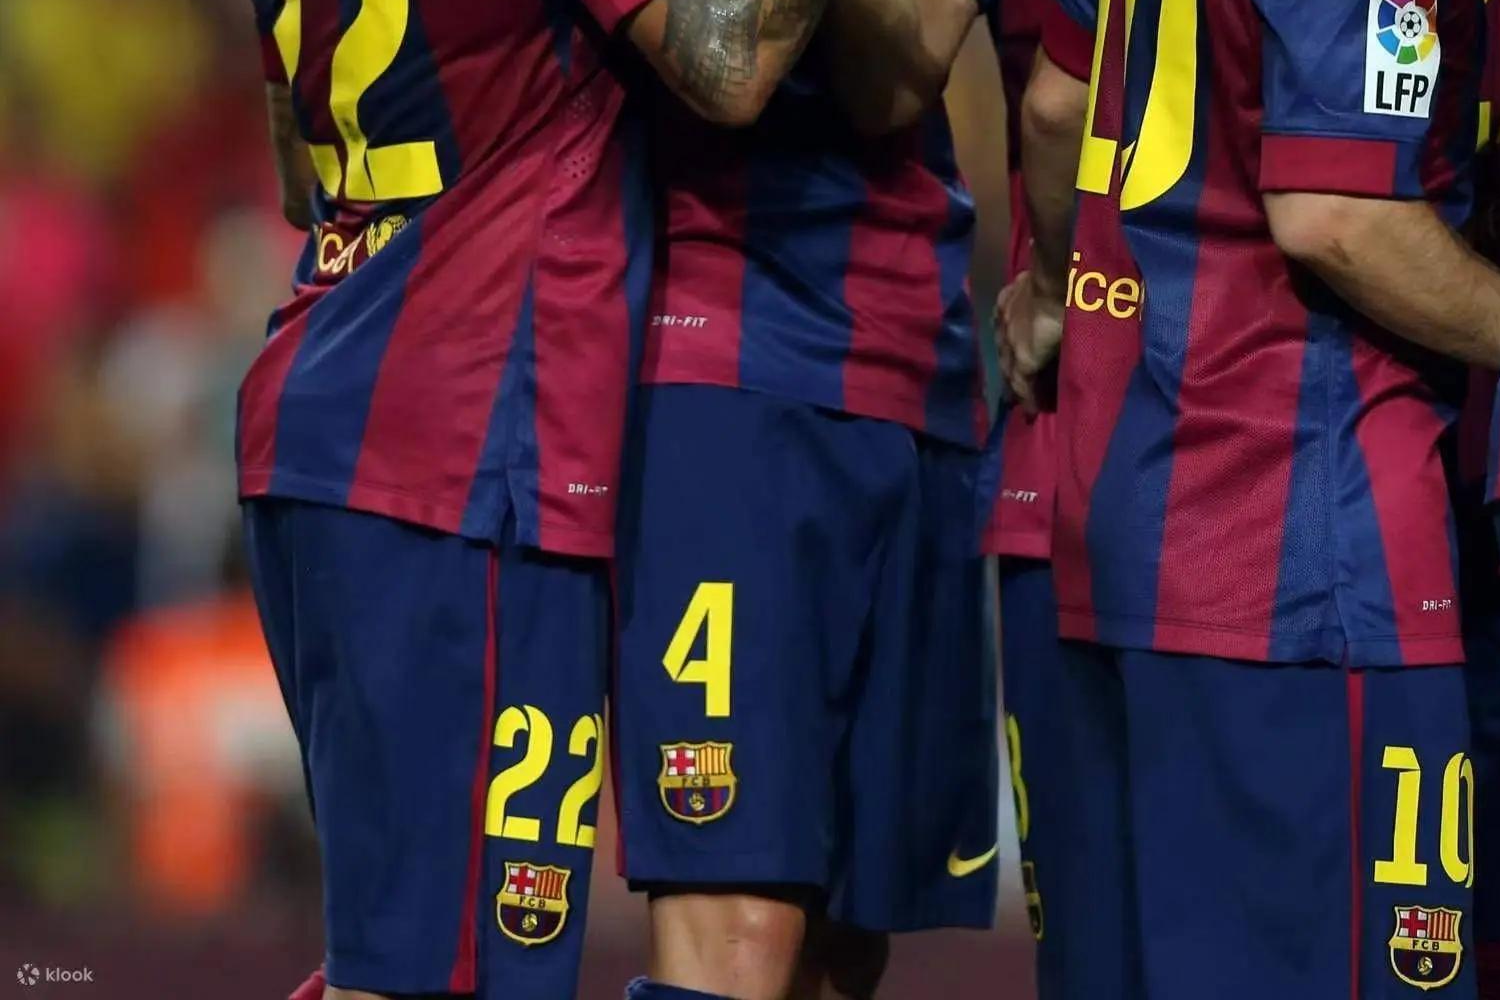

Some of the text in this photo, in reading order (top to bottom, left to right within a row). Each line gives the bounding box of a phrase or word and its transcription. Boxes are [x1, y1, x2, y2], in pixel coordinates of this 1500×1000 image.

[1376, 70, 1429, 113] LFP
[1065, 251, 1145, 321] ice
[662, 582, 734, 717] 4
[485, 704, 602, 848] 22
[1374, 745, 1474, 889] 10
[1412, 939, 1440, 951] FCB
